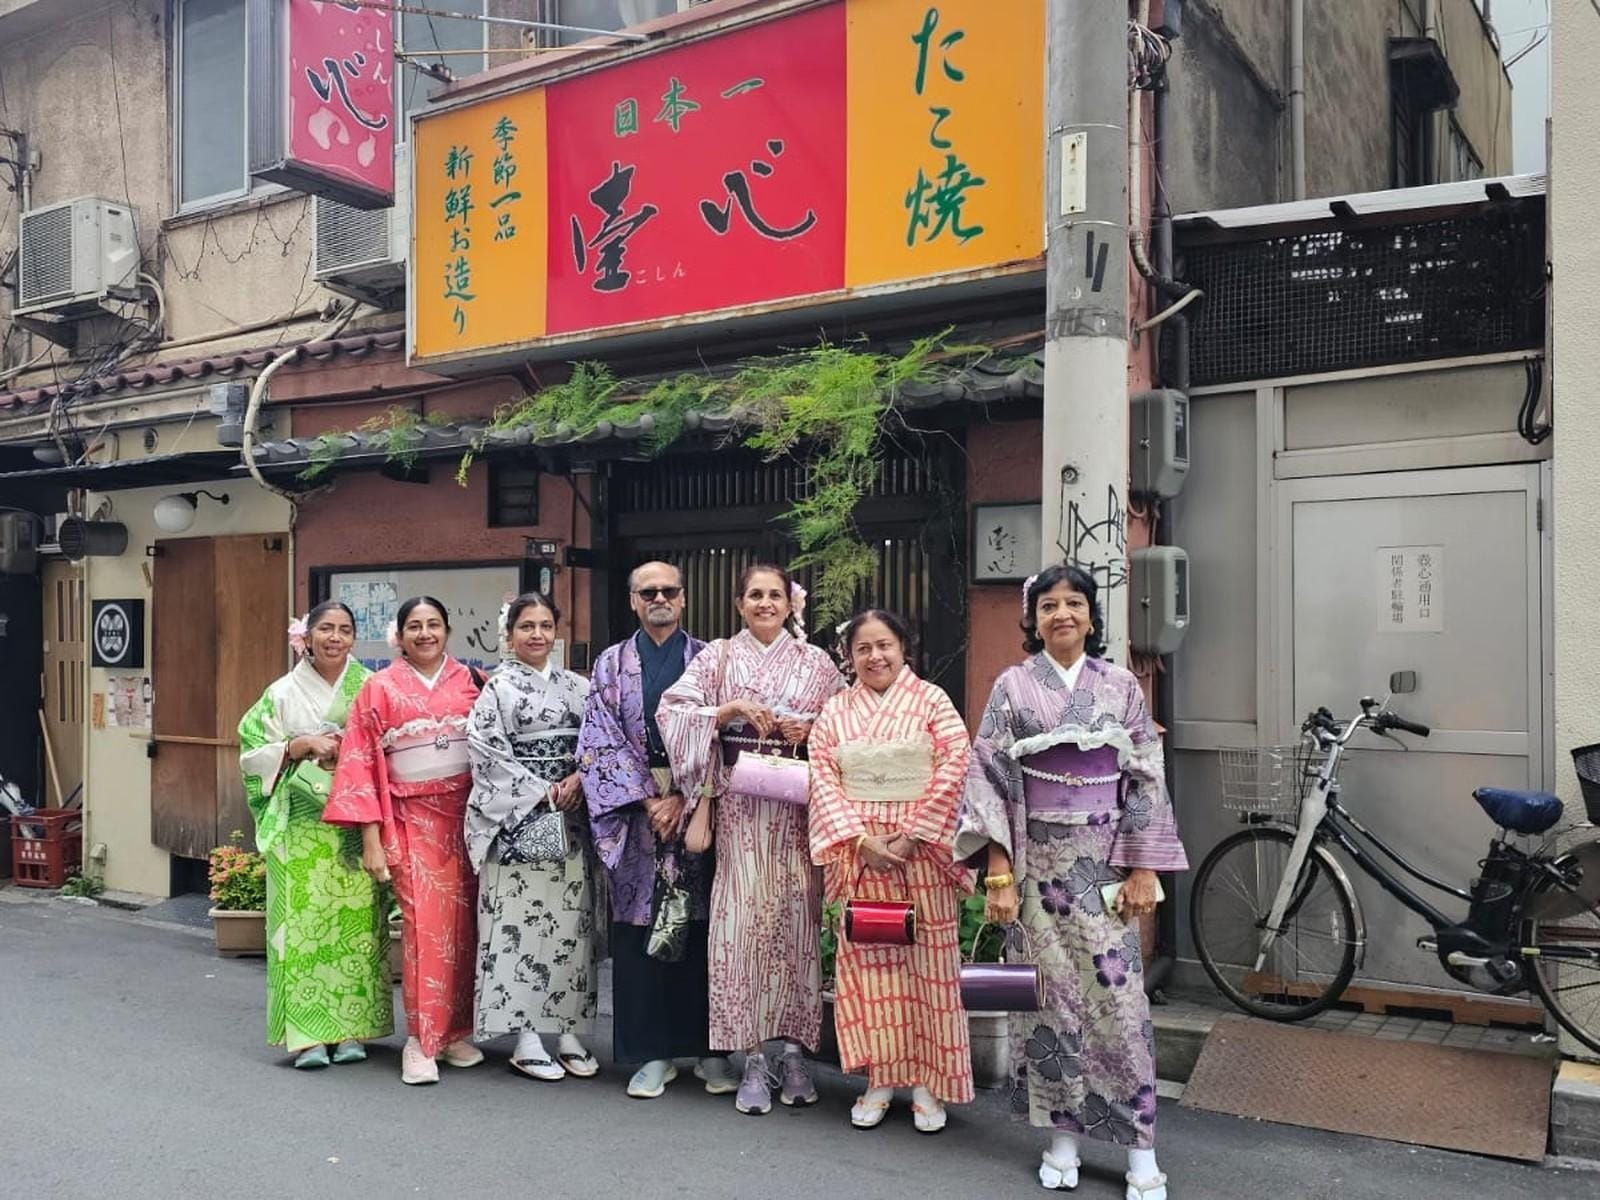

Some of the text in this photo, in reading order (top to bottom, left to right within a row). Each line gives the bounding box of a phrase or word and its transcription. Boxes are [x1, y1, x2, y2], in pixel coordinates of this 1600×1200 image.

[614, 77, 765, 137] 日本一
[905, 8, 986, 247] たこ焼
[443, 145, 477, 335] 新鮮お造り
[489, 116, 522, 242] 季節一品
[635, 262, 686, 284] こしん
